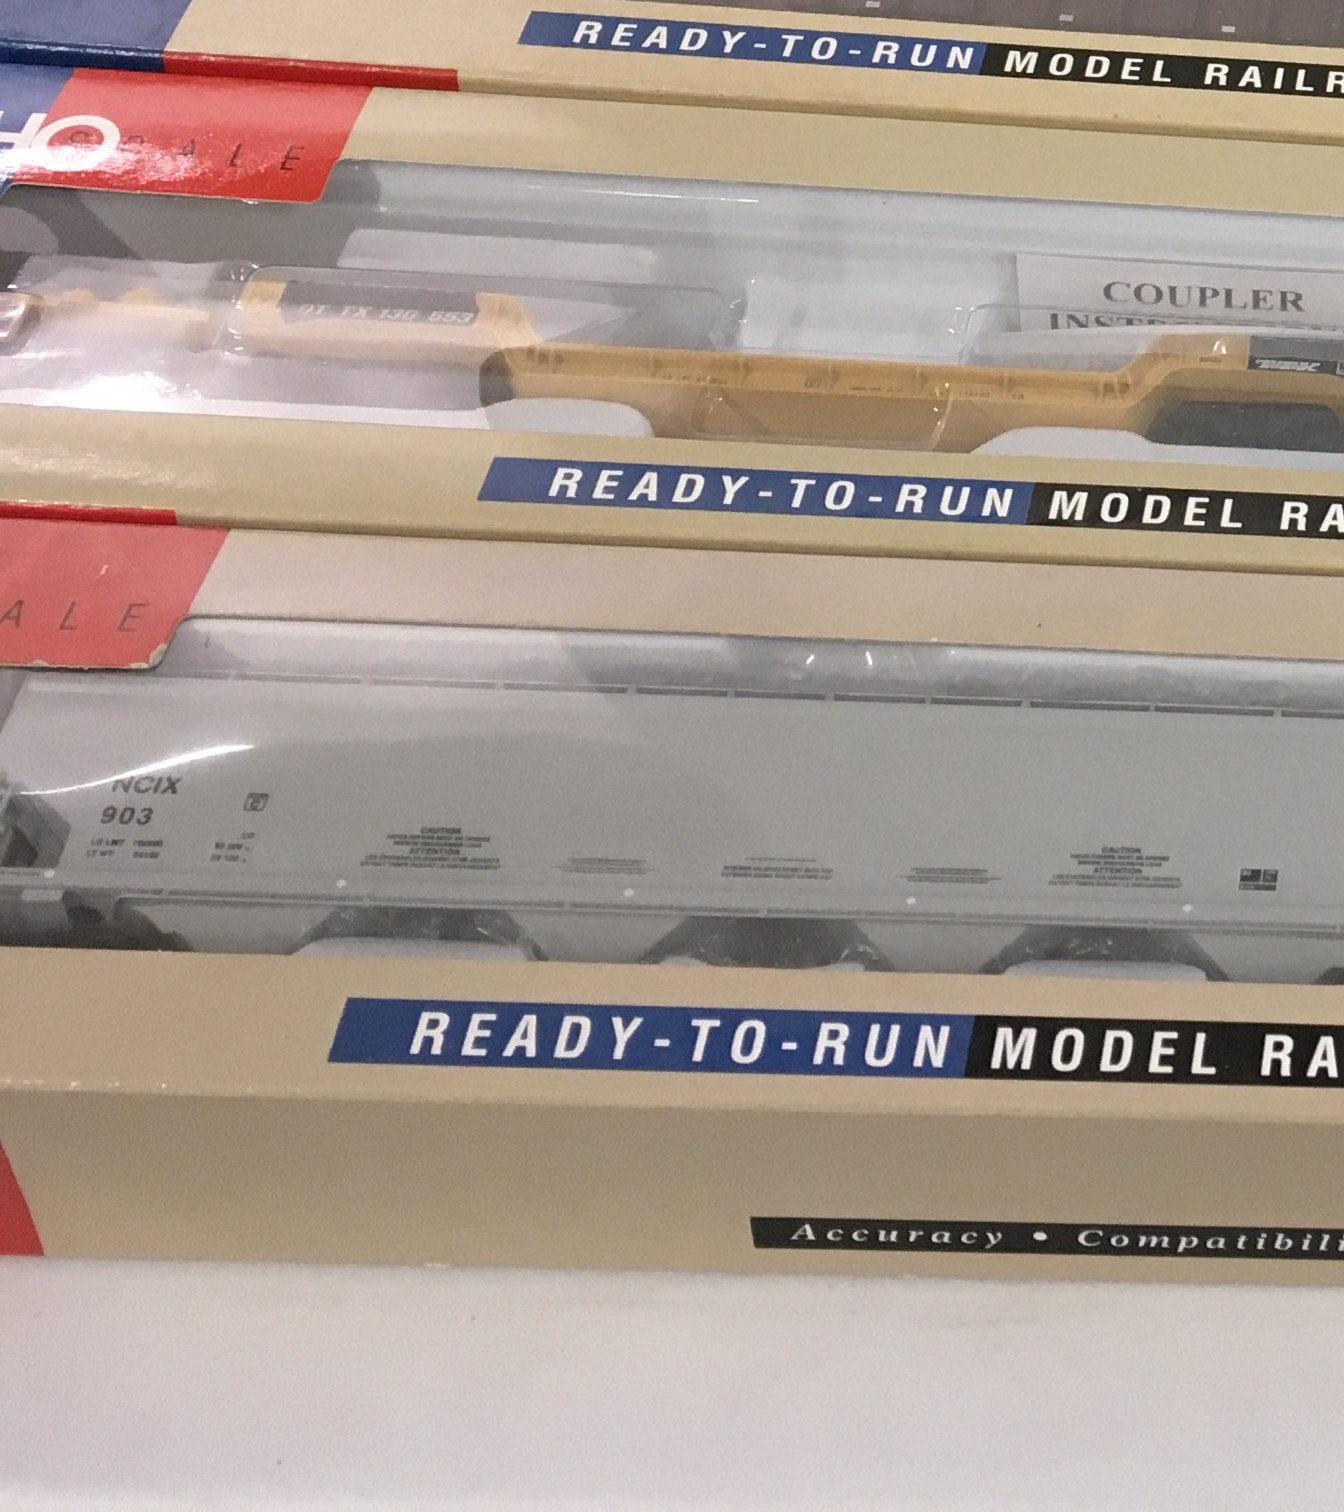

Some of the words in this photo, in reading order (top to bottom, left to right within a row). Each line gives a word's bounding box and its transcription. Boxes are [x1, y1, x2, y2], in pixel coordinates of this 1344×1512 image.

[572, 19, 977, 72] READY-TO-RUN
[1002, 48, 1174, 86] MODEL
[1102, 280, 1307, 313] COUPLER
[548, 466, 1014, 519] READY-TO-RUN
[1047, 490, 1245, 529] MODEL
[111, 775, 182, 796] NCIX
[100, 805, 154, 827] 903
[409, 1009, 952, 1071] READY-TO-RUN
[989, 1025, 1217, 1077] MODEL
[790, 1221, 1005, 1250] Accuracy
